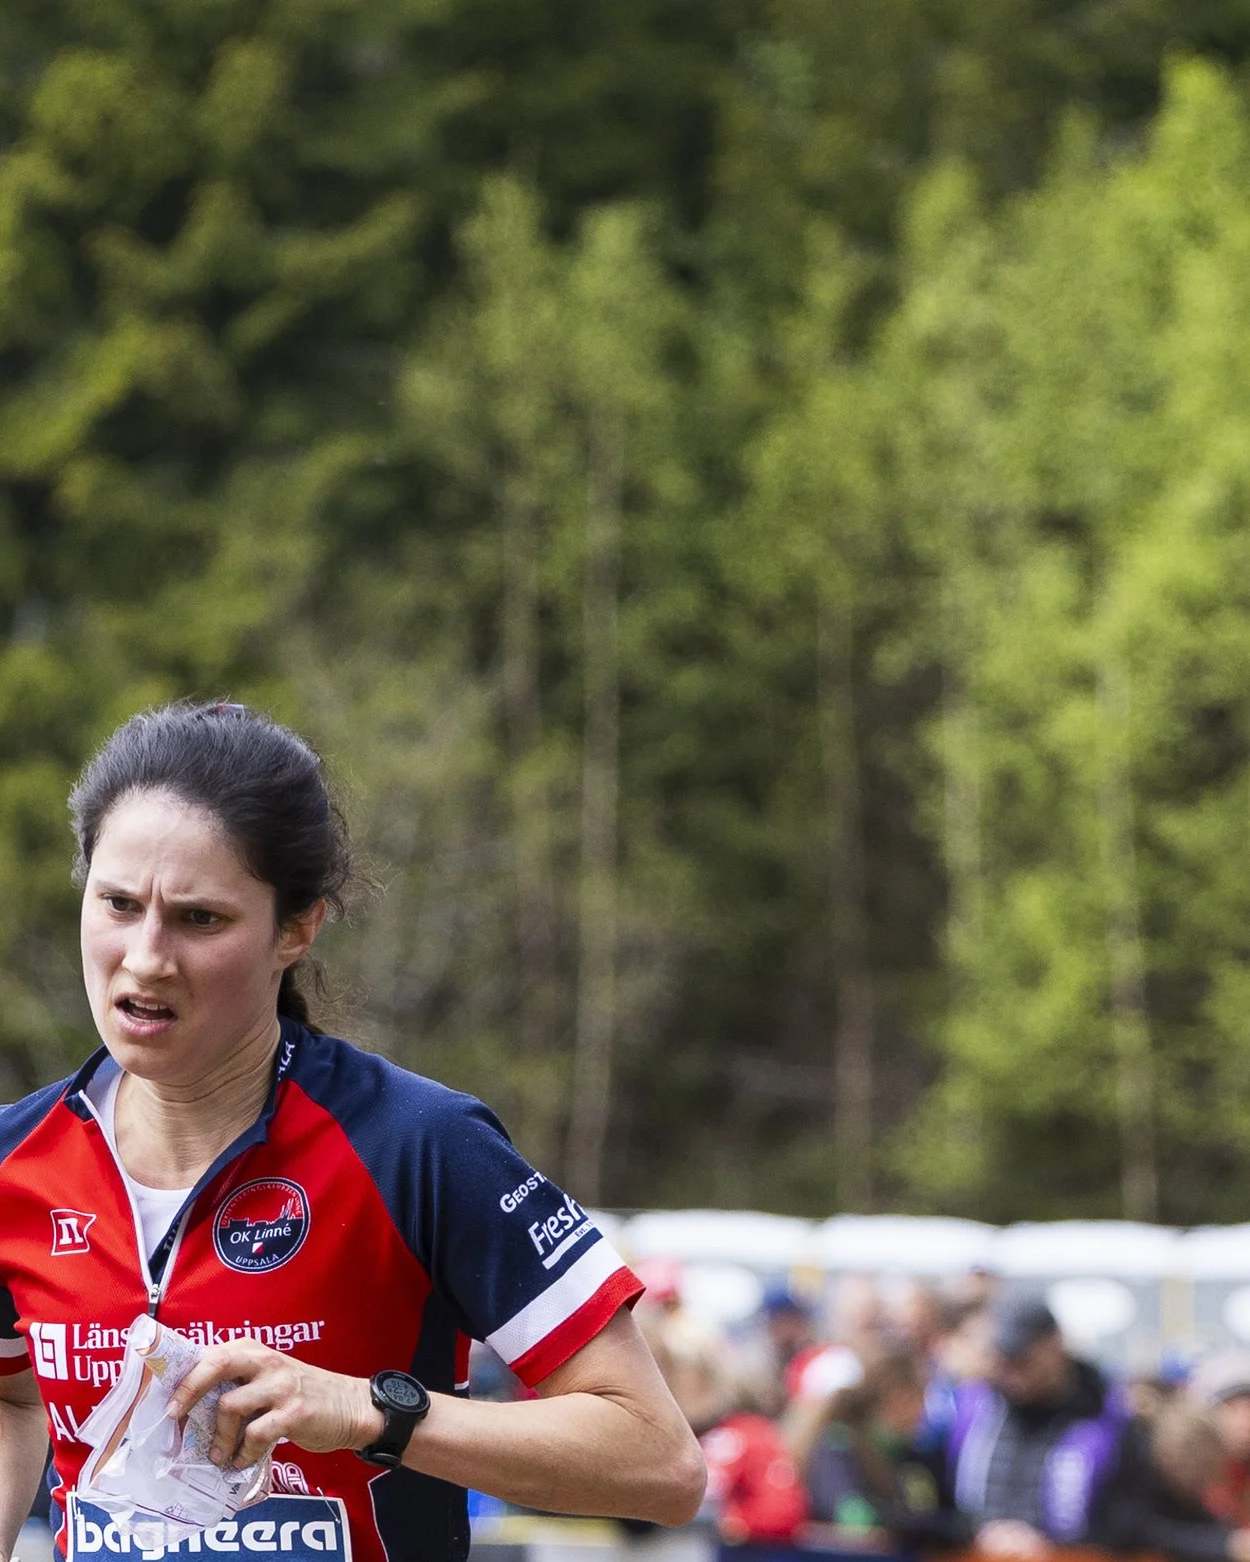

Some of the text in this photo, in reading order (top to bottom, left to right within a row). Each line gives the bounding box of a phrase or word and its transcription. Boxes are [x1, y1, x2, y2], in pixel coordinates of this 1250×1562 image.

[230, 1223, 292, 1244] OK Linné
[235, 1254, 279, 1267] UPPSALA
